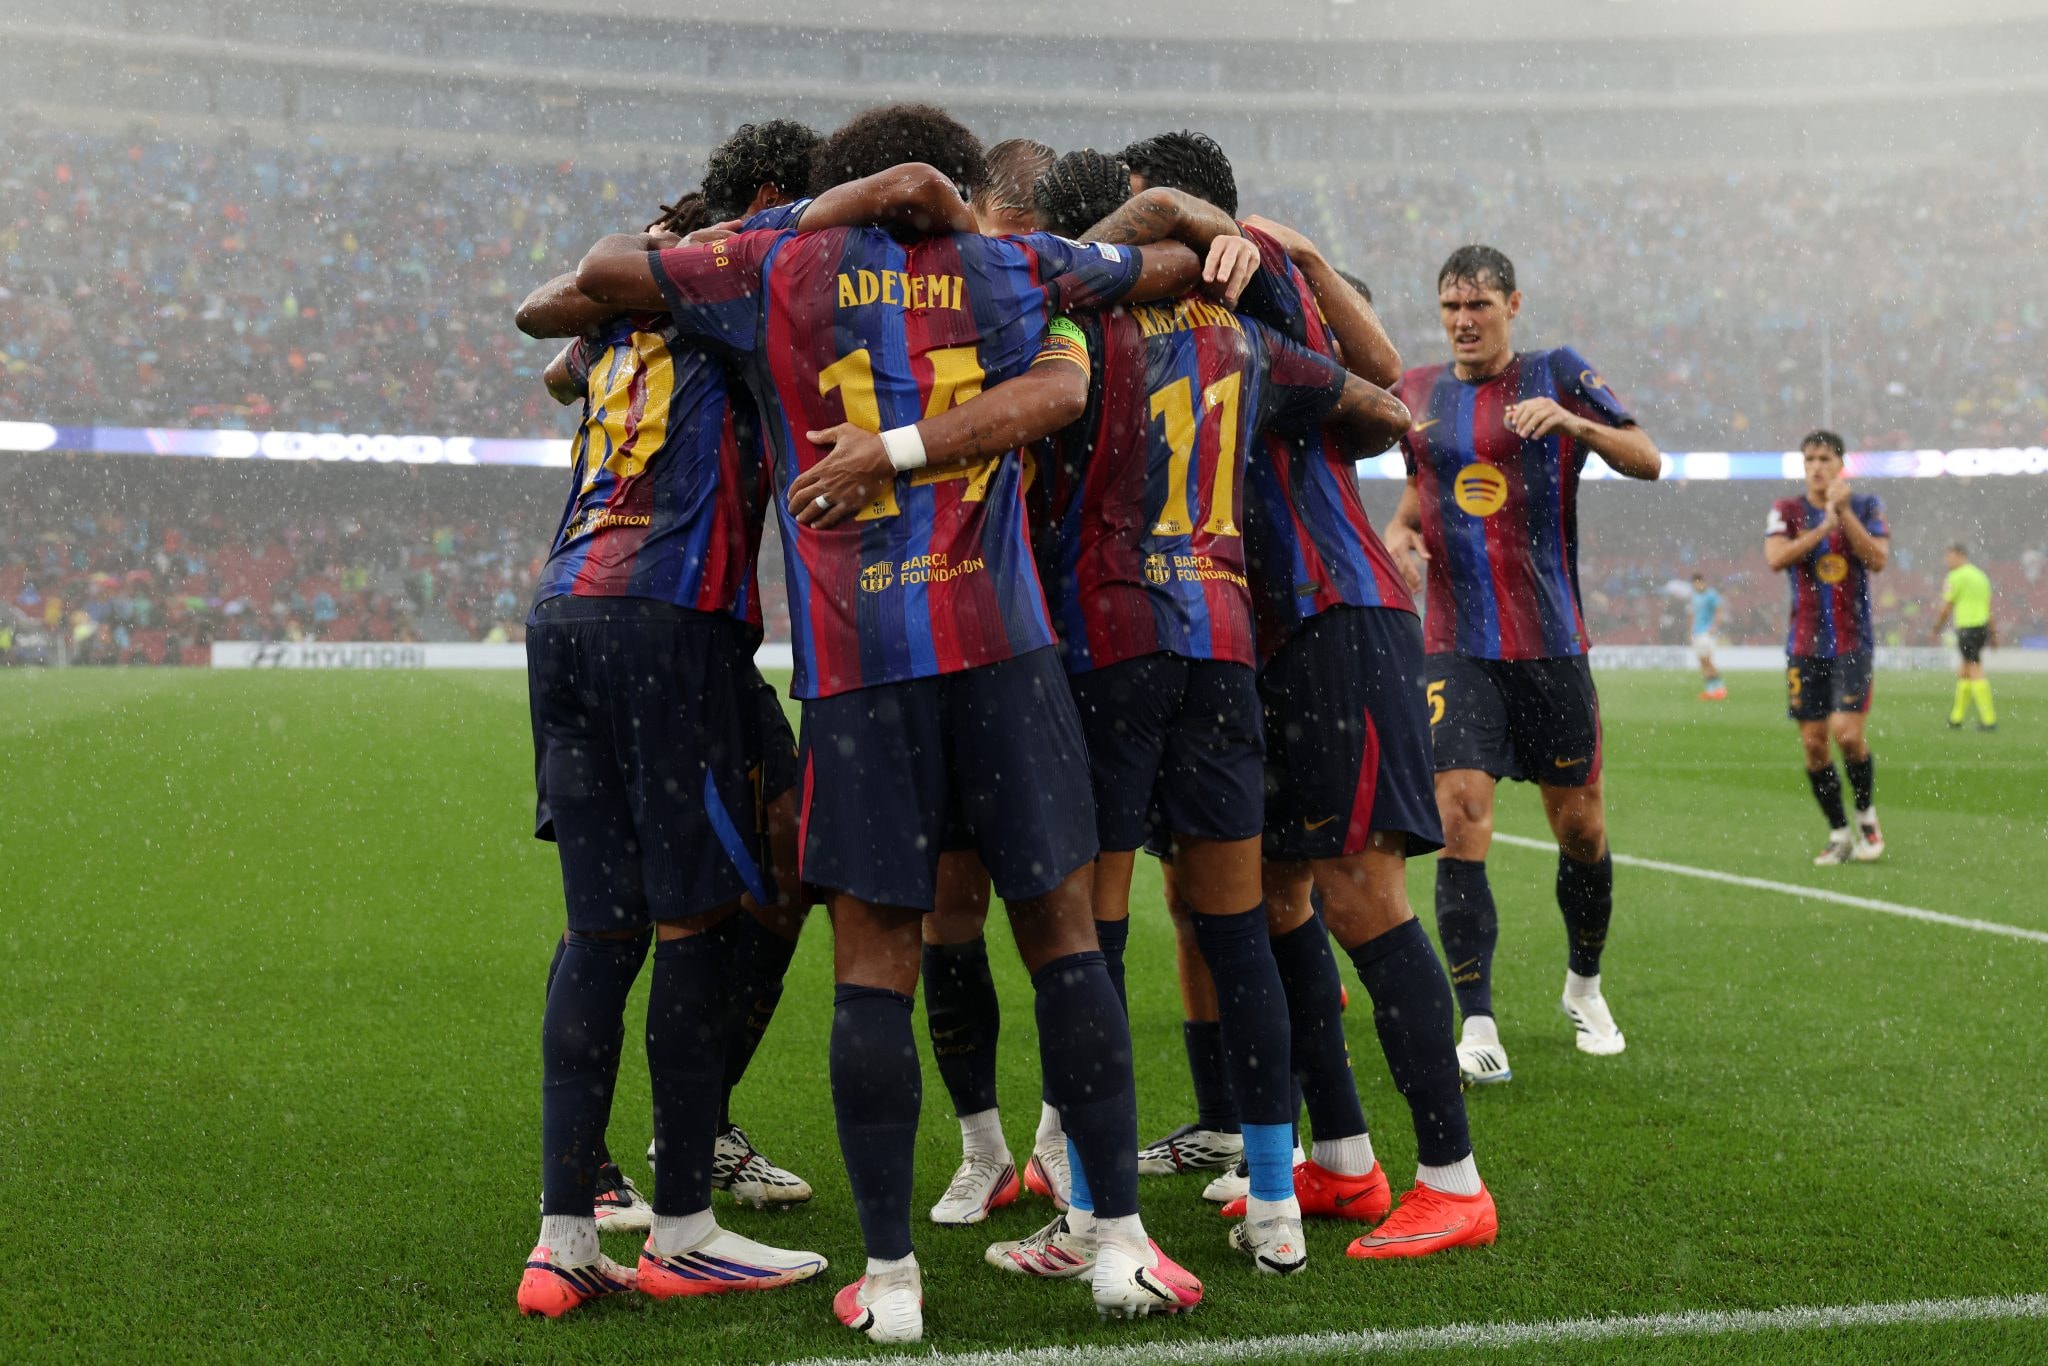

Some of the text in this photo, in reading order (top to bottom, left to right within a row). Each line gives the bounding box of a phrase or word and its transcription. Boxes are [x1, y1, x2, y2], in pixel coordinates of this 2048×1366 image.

[837, 269, 964, 312] ADEYEMI
[818, 346, 1000, 522] 14
[1149, 370, 1241, 537] 11
[900, 553, 948, 571] BARÇA
[1172, 556, 1214, 570] BARÇA
[302, 646, 425, 669] HYUNDAI
[1426, 679, 1447, 726] 5
